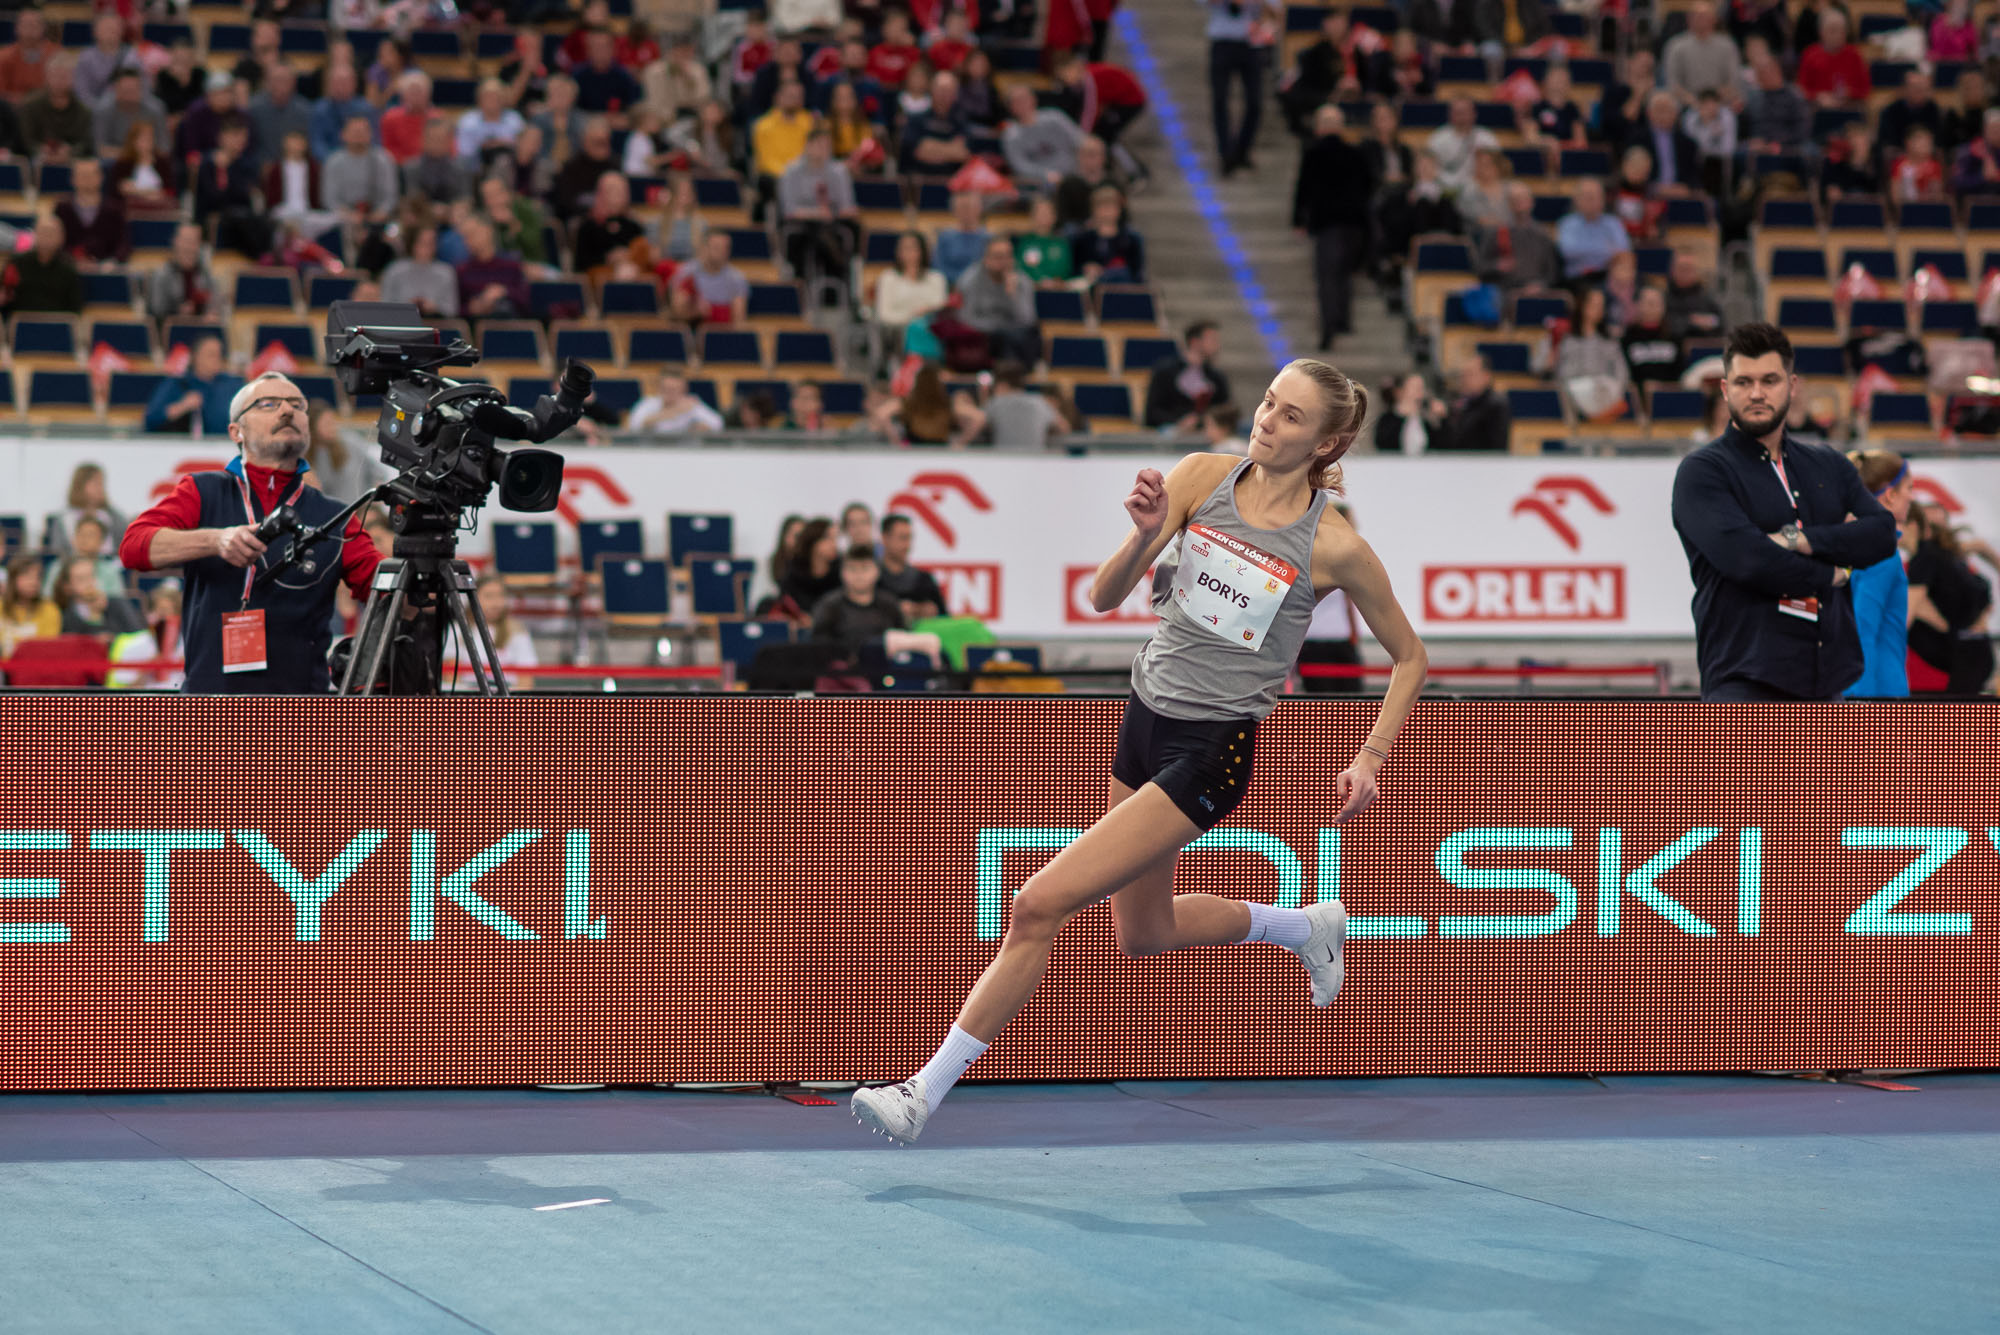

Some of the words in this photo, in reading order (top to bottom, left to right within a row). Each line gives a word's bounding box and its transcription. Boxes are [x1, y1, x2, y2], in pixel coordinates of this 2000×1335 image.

[1200, 527, 1228, 544] ORLEN
[1228, 539, 1245, 553] CUP
[1244, 547, 1269, 566] ŁÓDŹ
[1267, 560, 1288, 577] 2020
[1197, 571, 1250, 609] BORYS
[1430, 570, 1616, 618] ORLEN
[1841, 826, 2000, 937] Z
